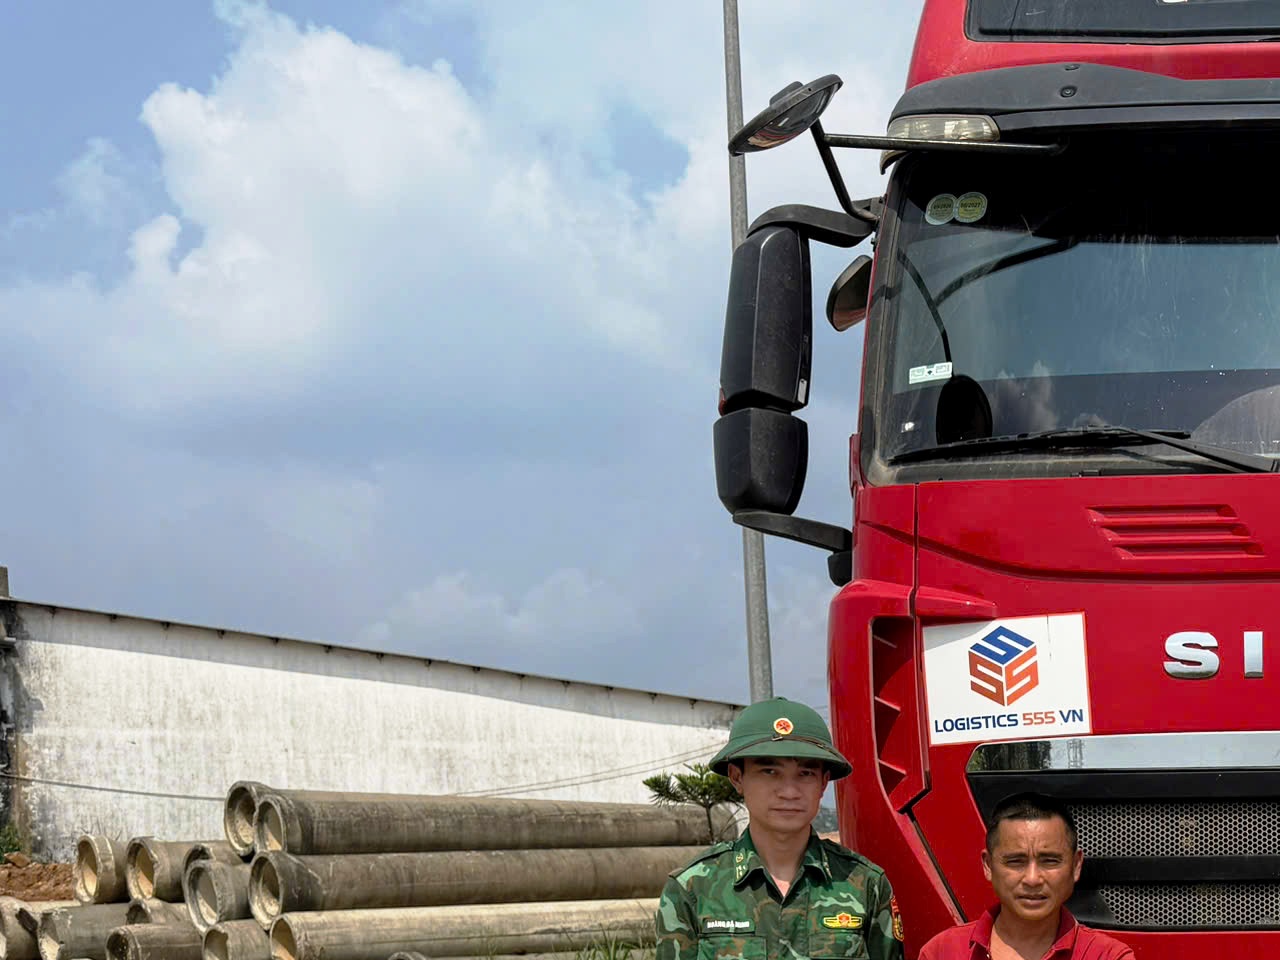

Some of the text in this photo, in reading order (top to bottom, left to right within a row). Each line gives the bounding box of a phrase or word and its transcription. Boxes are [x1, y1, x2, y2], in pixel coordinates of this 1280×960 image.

[935, 708, 1084, 733] LOGISTICS 555 VN
